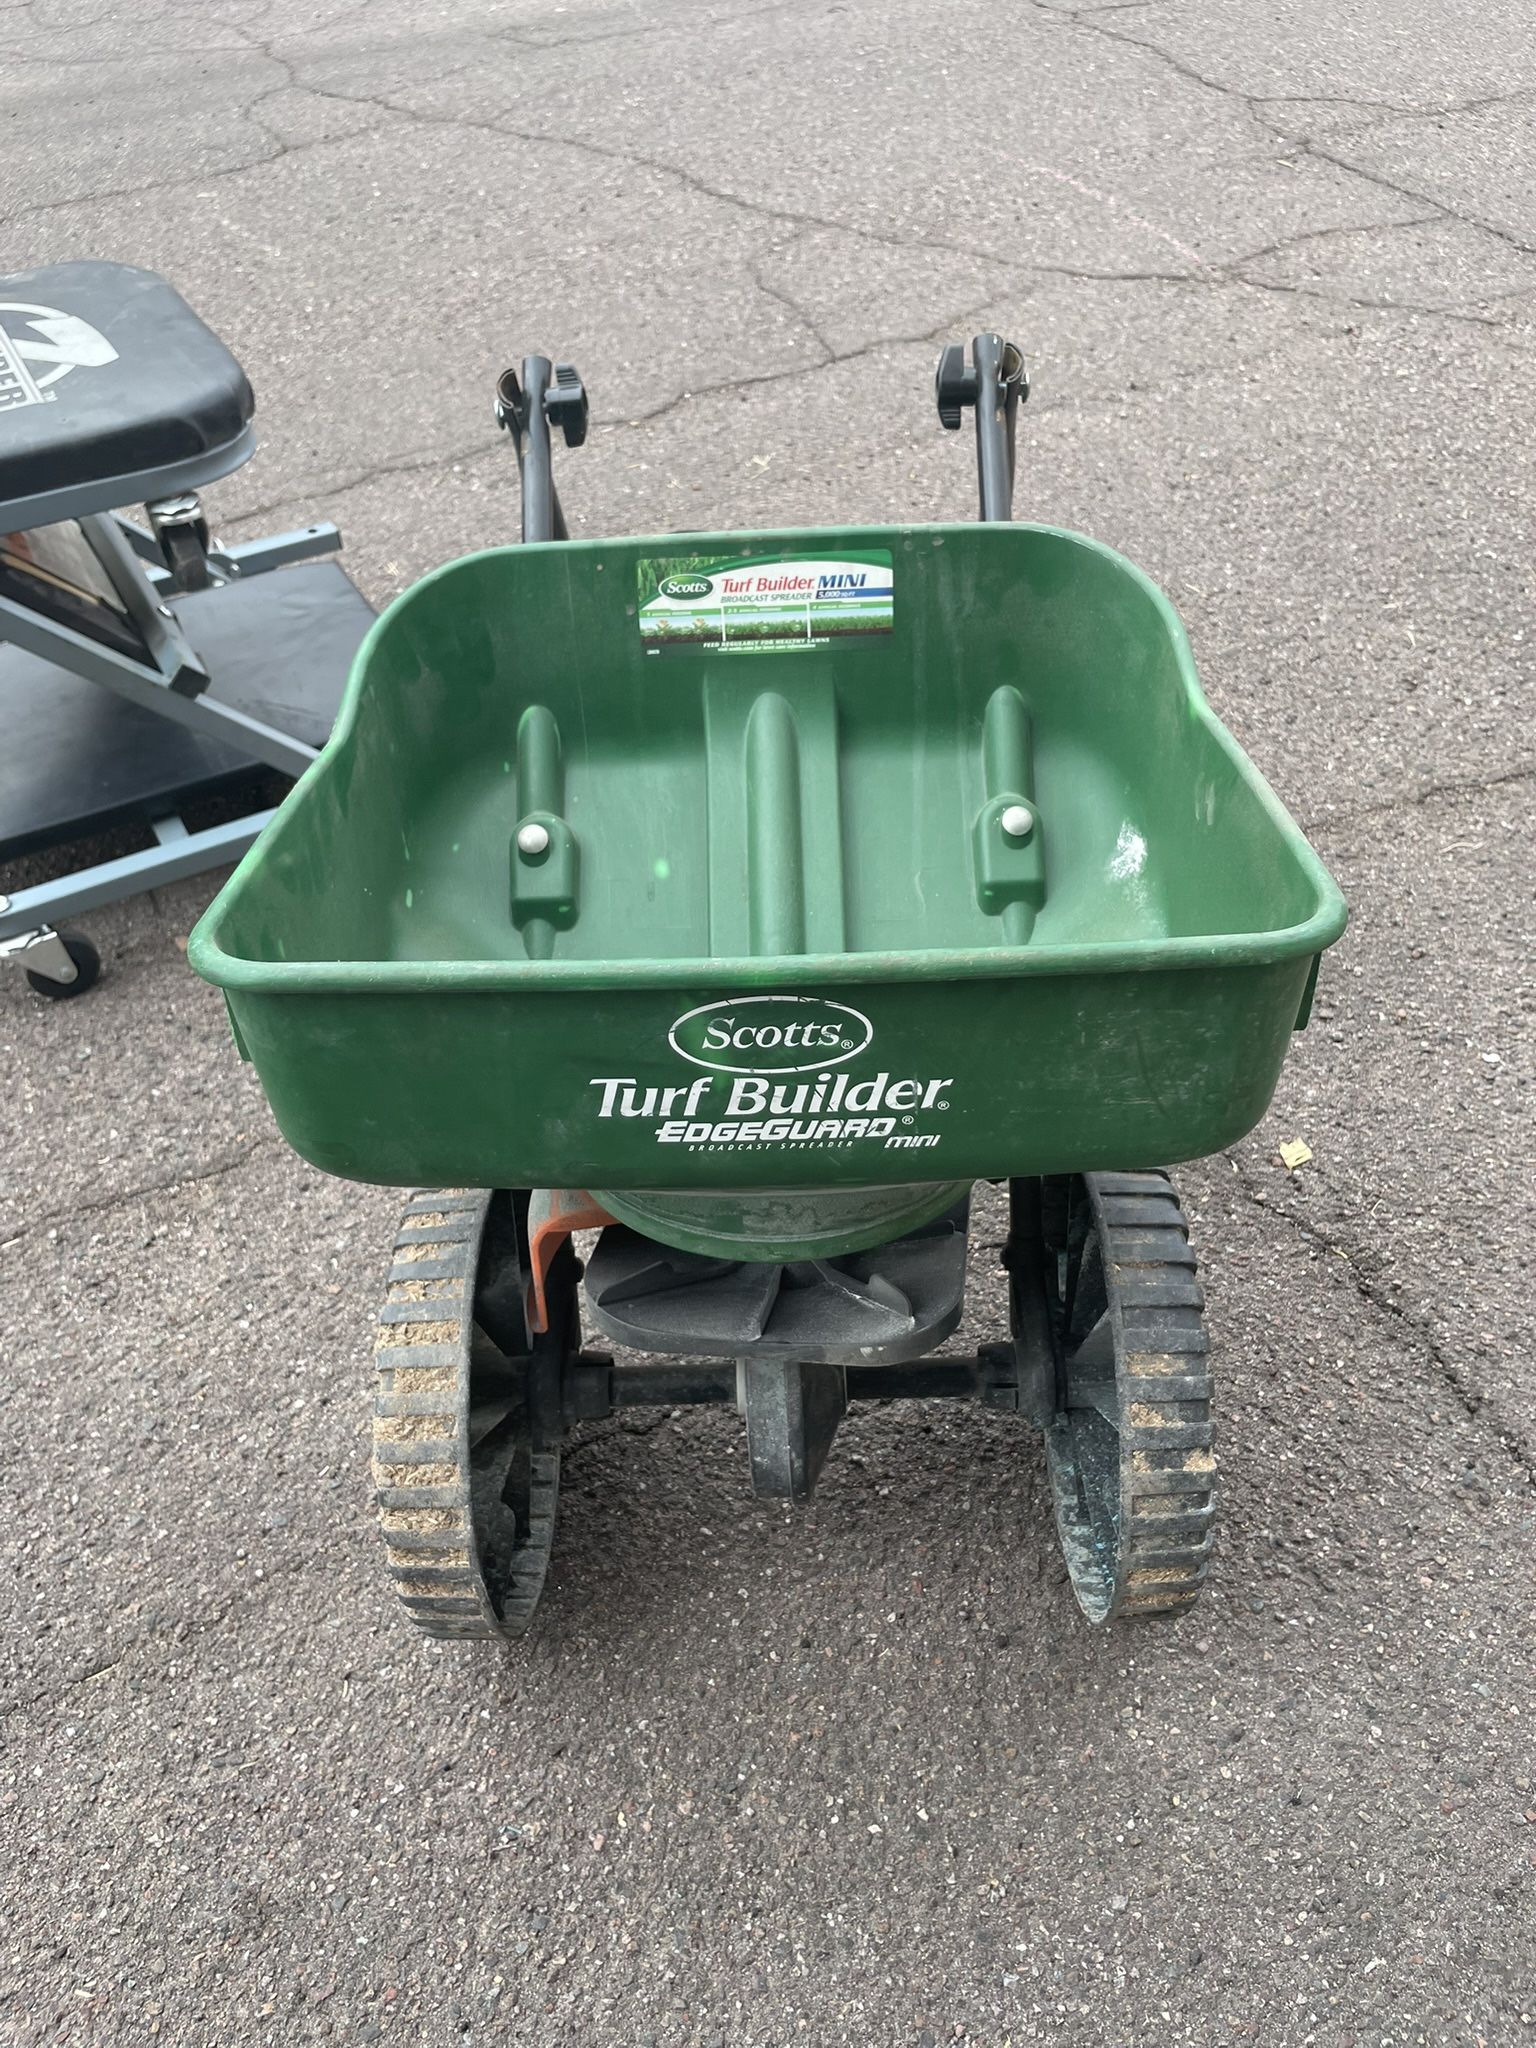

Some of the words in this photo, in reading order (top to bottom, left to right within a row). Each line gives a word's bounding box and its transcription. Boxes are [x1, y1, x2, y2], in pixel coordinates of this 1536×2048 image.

[667, 581, 707, 594] Scotts
[722, 578, 753, 593] Turf
[756, 576, 814, 592] Builder
[818, 573, 866, 589] MINI
[720, 594, 768, 603] BROADCAST
[770, 592, 812, 601] SPREADER
[589, 1076, 714, 1118] Turf
[688, 1142, 772, 1152] BROADCAST
[780, 1140, 855, 1150] SPREADER
